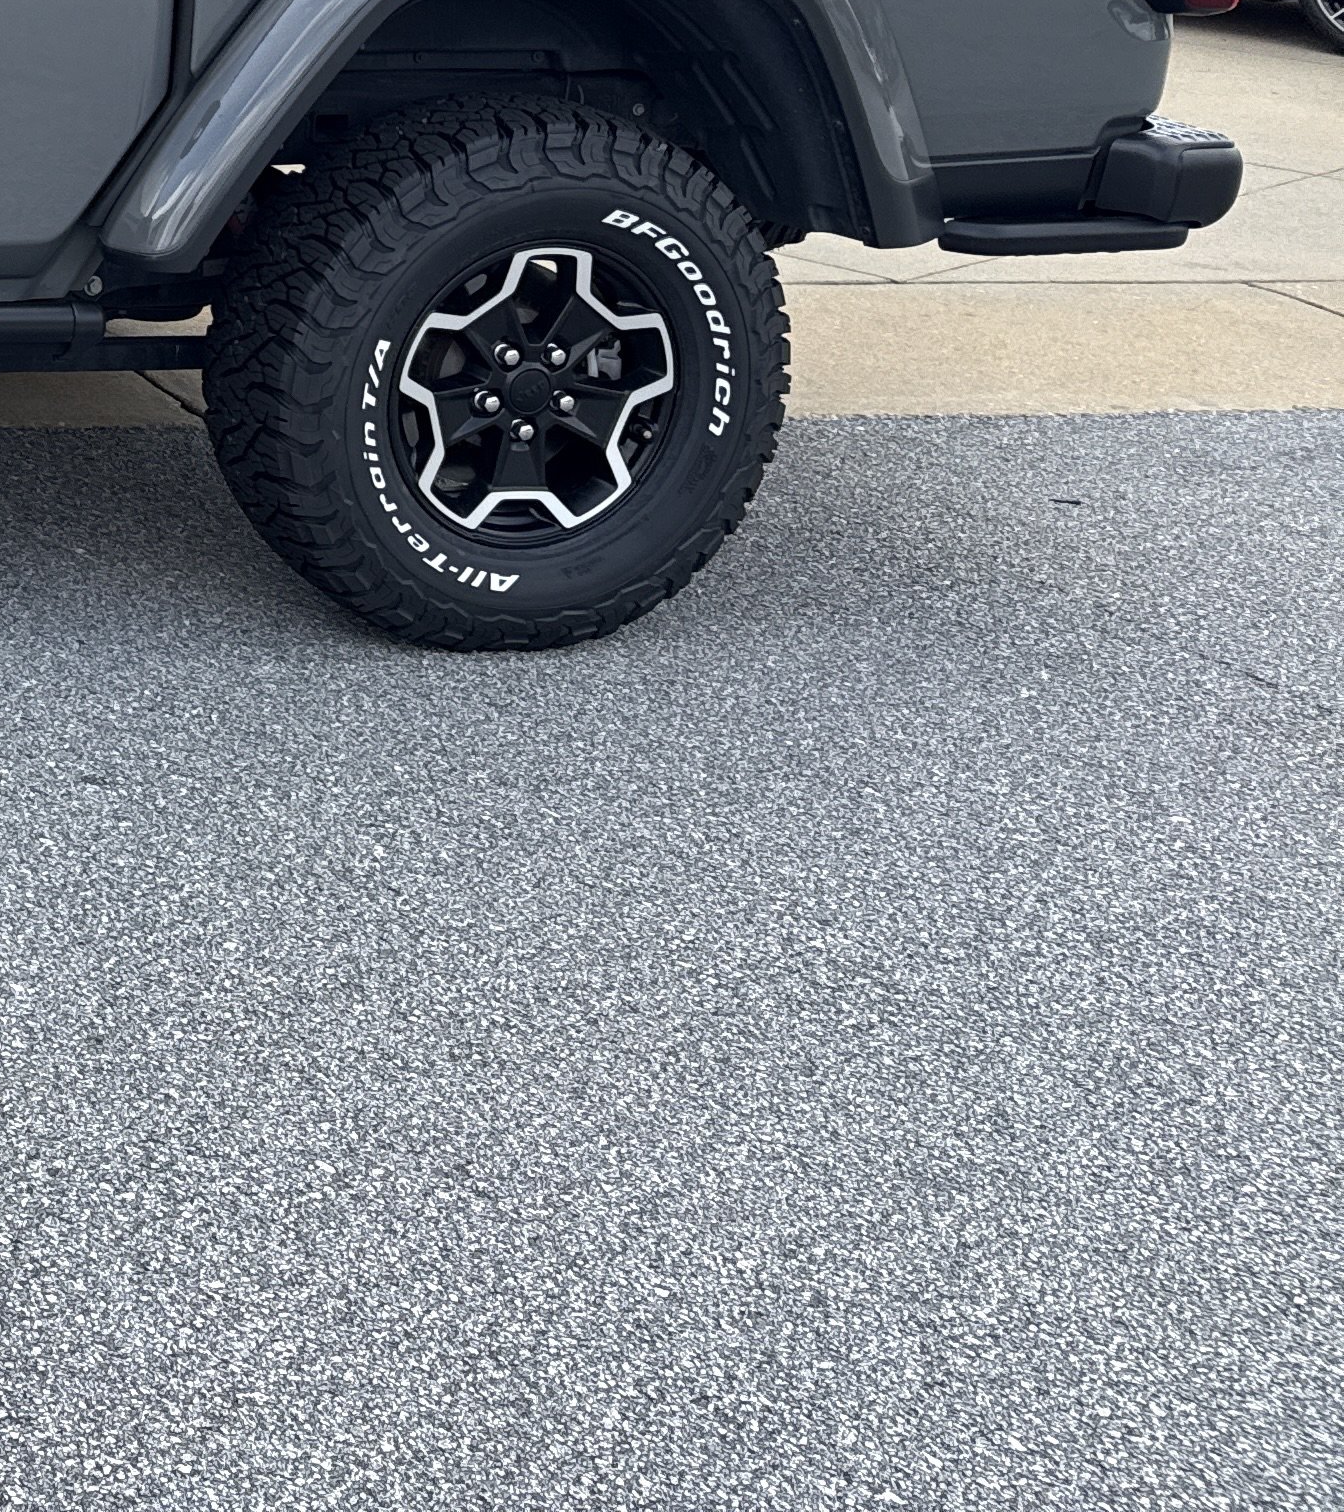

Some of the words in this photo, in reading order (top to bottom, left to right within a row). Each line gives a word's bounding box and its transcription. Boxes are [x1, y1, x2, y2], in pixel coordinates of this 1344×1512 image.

[361, 338, 392, 411] T/A
[601, 208, 734, 437] BFGoodrich
[363, 420, 521, 593] All-Terrain
